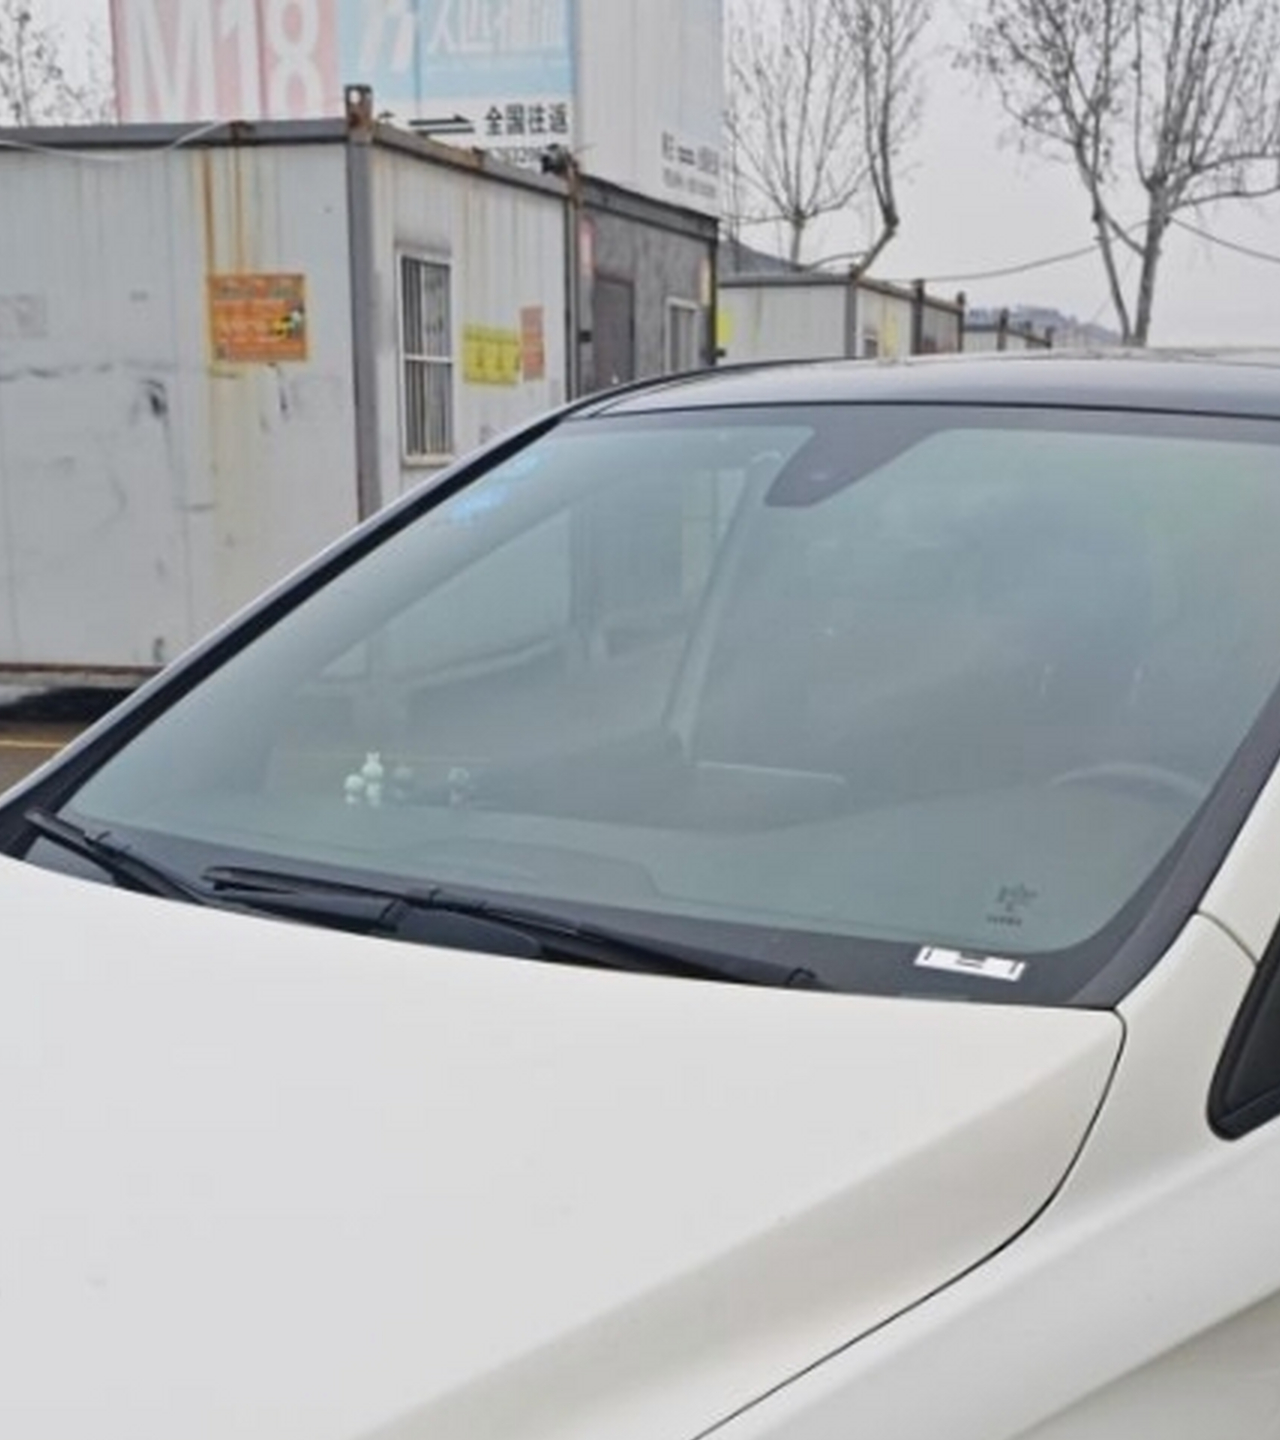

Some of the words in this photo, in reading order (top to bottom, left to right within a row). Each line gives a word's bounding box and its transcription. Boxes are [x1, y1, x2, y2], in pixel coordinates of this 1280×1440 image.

[122, 0, 326, 122] M18
[485, 103, 568, 135] 全国往返
